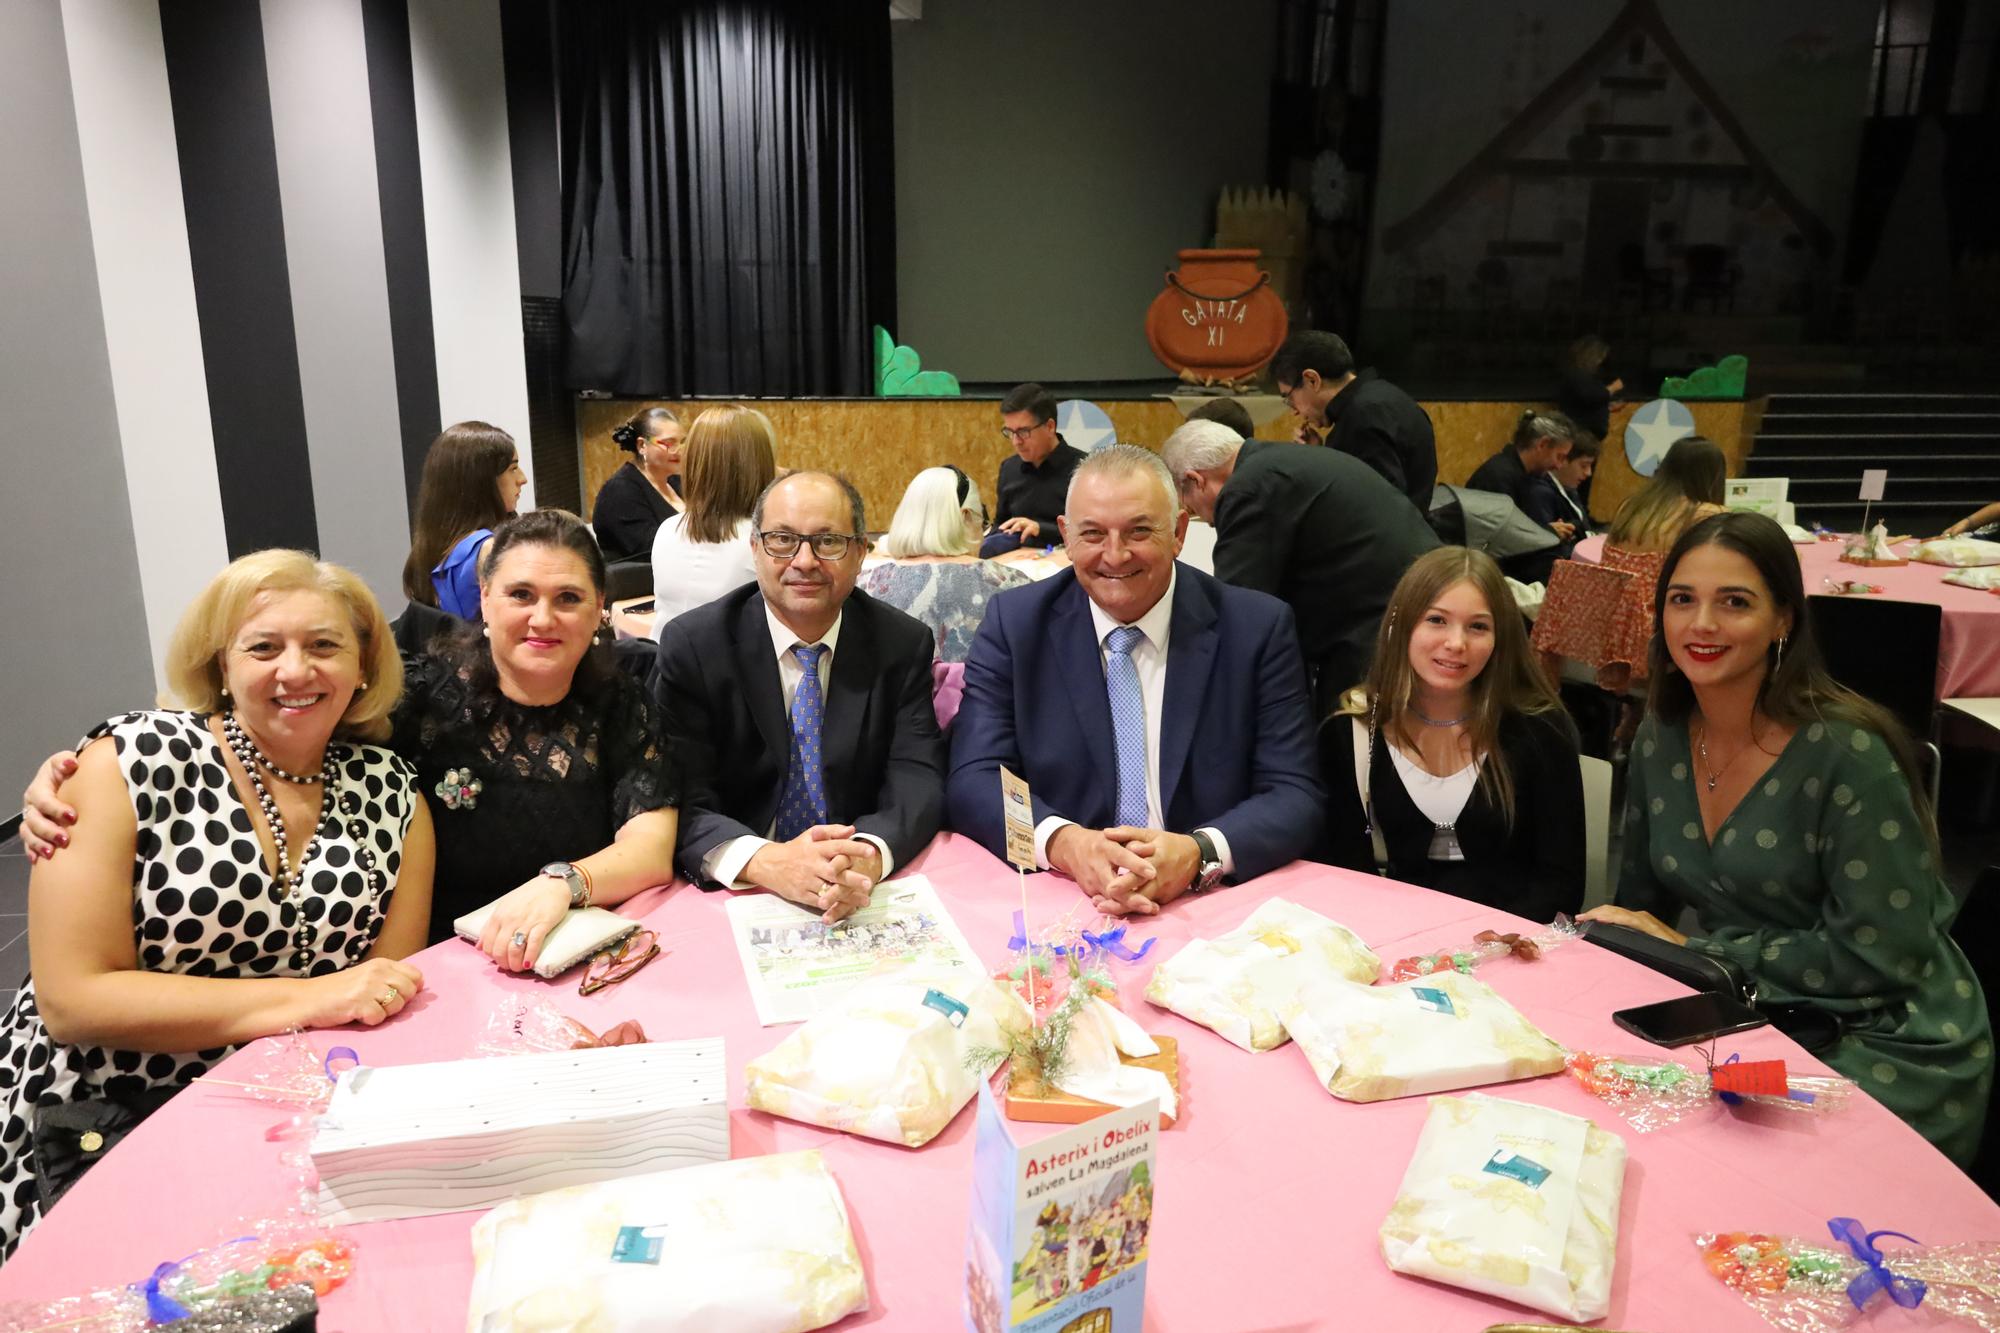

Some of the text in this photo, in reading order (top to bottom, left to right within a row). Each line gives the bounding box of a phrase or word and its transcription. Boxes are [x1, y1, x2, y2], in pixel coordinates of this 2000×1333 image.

[1182, 300, 1247, 326] GAIATA
[1208, 326, 1224, 346] XI
[1025, 1119, 1151, 1179] Asterix i Obelix
[1026, 1142, 1149, 1199] salven La Magdalena
